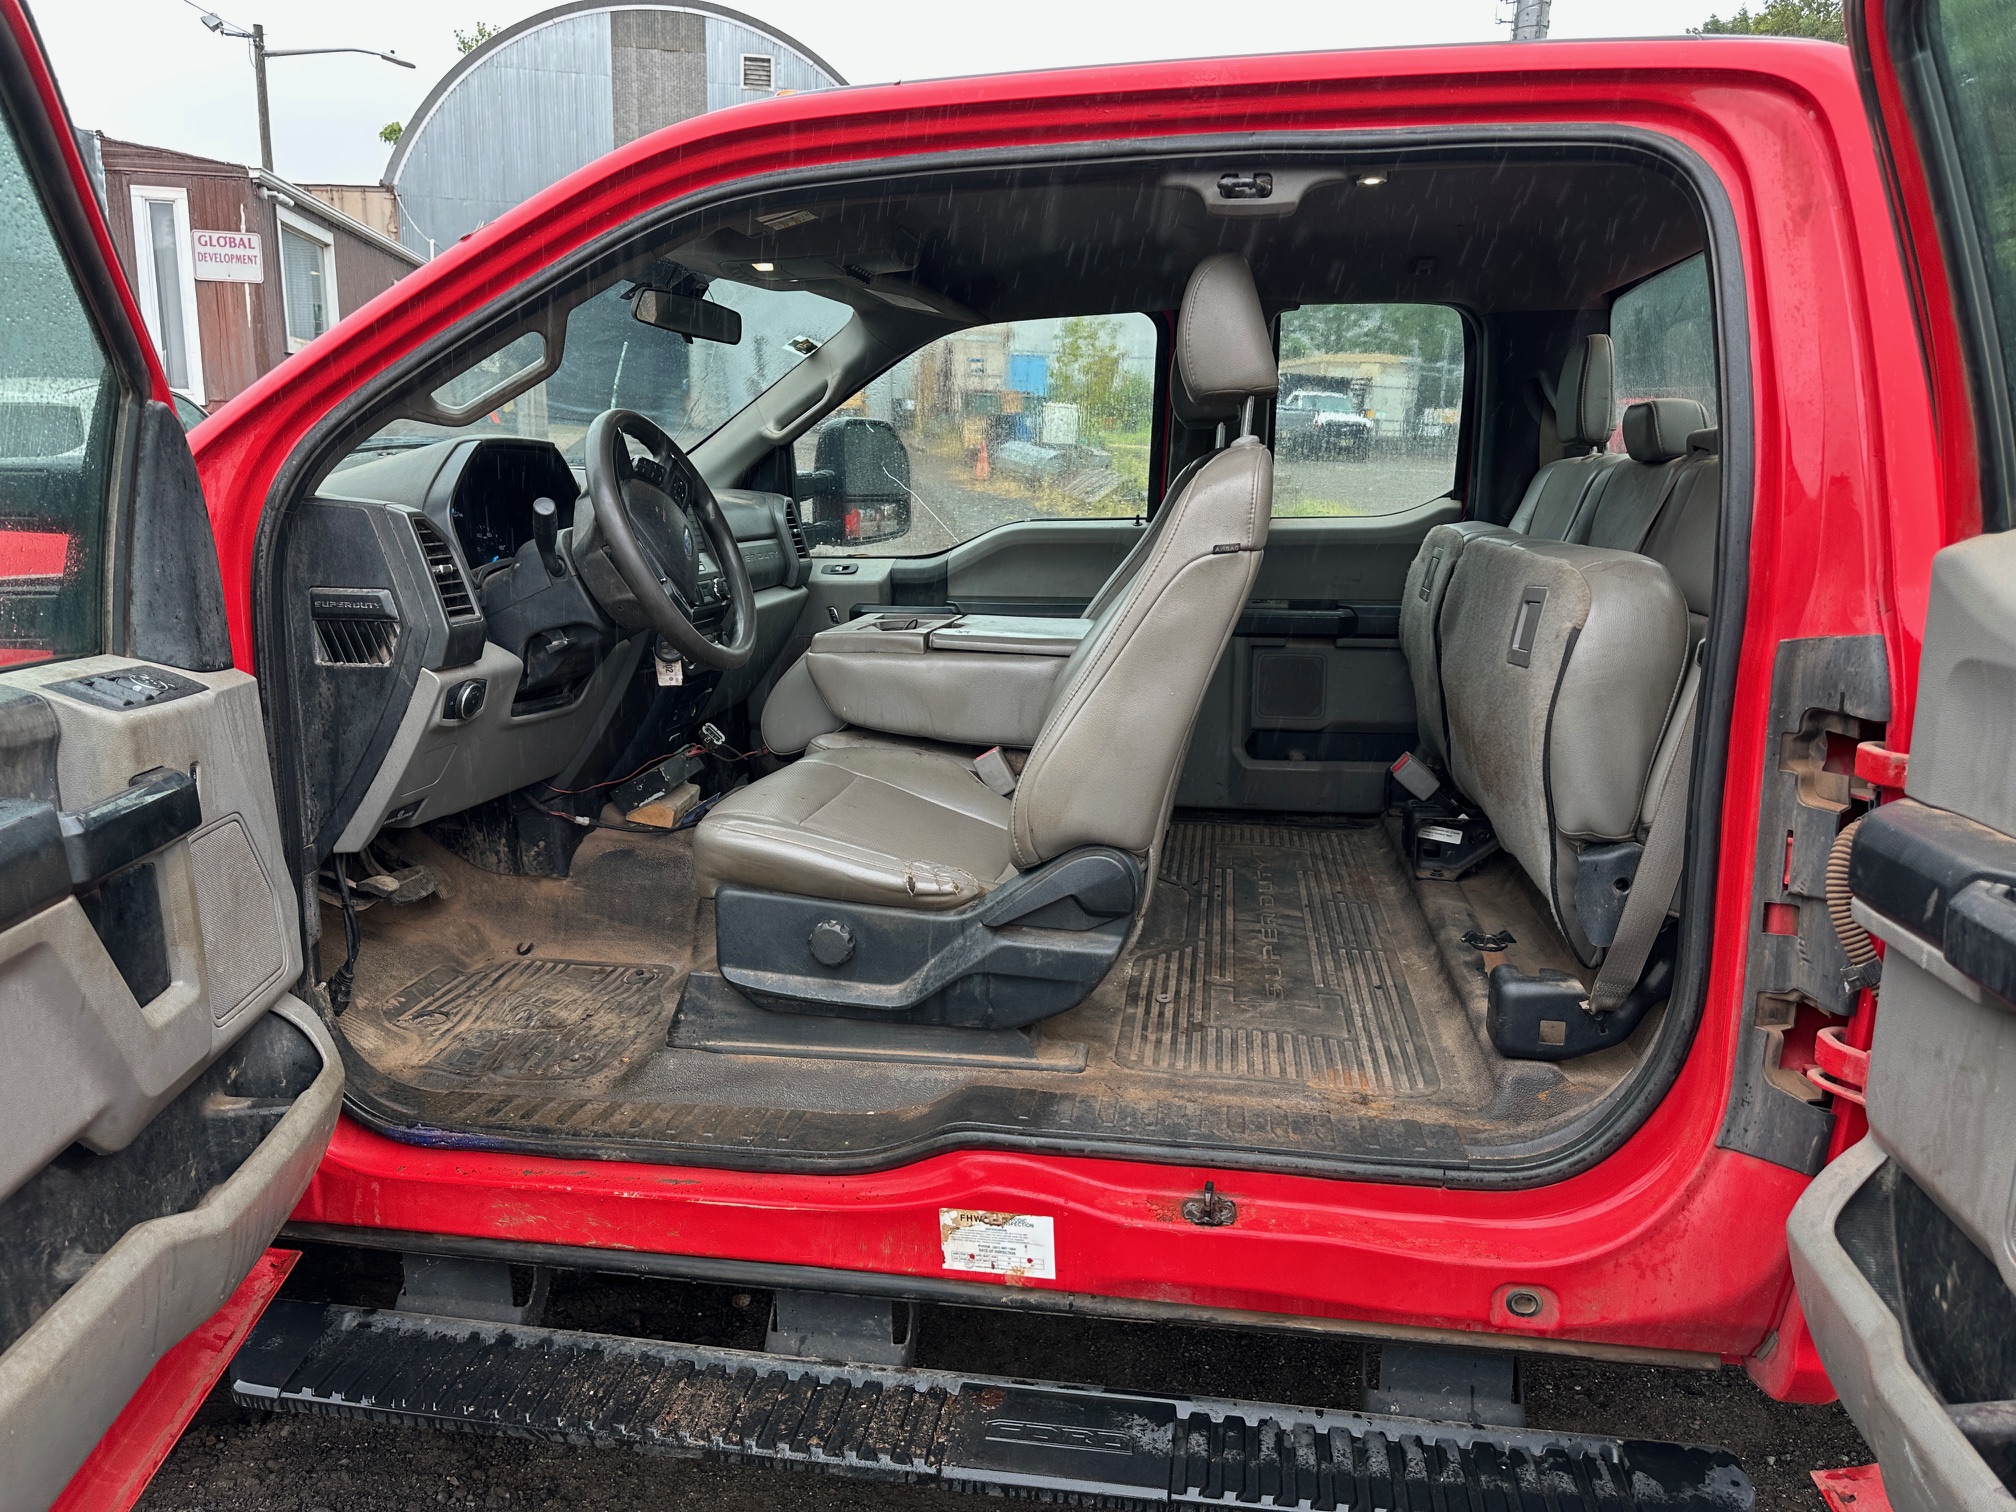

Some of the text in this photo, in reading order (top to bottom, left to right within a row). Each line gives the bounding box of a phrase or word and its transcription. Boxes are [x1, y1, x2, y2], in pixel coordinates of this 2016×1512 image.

[197, 234, 256, 250] GLOBAL
[197, 251, 258, 265] DEVELOPMENT
[1214, 545, 1240, 553] AIRBAG
